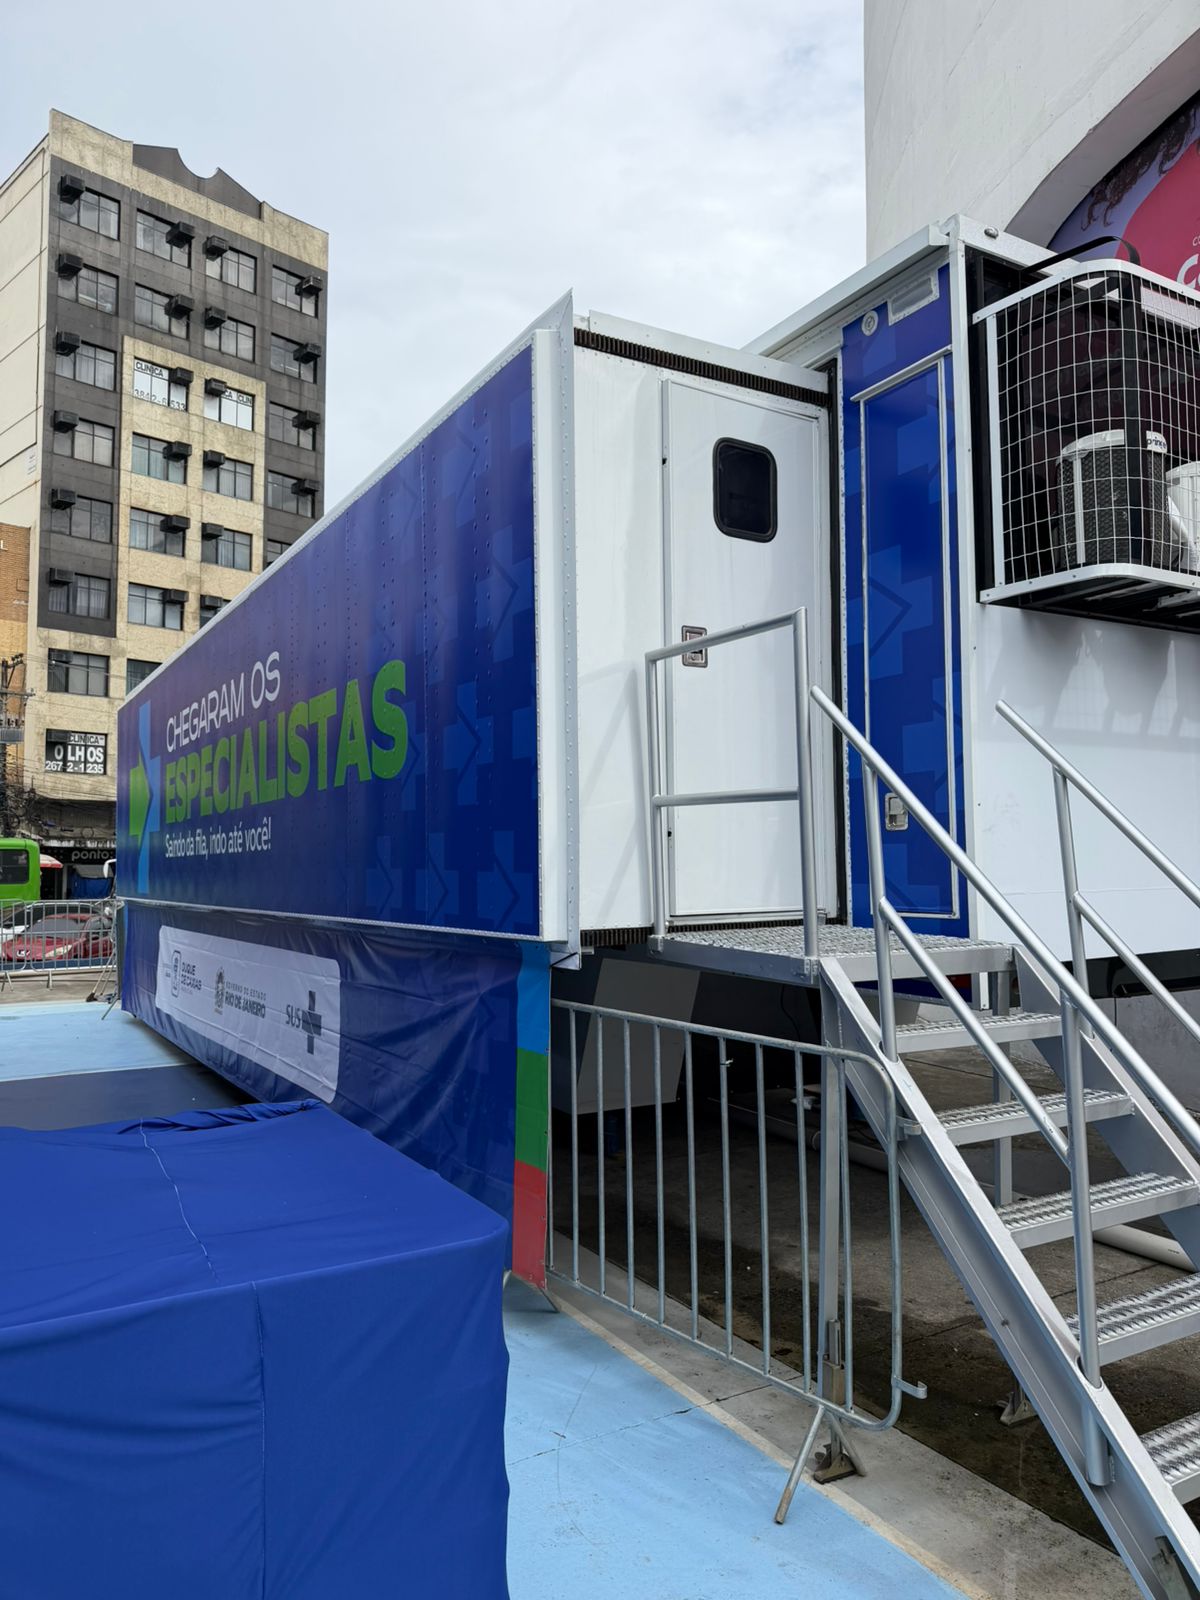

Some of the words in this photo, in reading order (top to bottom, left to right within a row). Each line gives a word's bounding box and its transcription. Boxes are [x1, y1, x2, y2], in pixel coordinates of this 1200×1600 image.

[166, 672, 245, 753] CHEGARAM
[250, 651, 281, 710] OS
[164, 659, 409, 824] ESPECIALISTAS
[165, 832, 186, 858] Saindo
[186, 830, 194, 856] da
[209, 825, 227, 855] indo
[228, 821, 243, 853] até
[245, 816, 272, 852] você!
[285, 1003, 301, 1029] SUS
